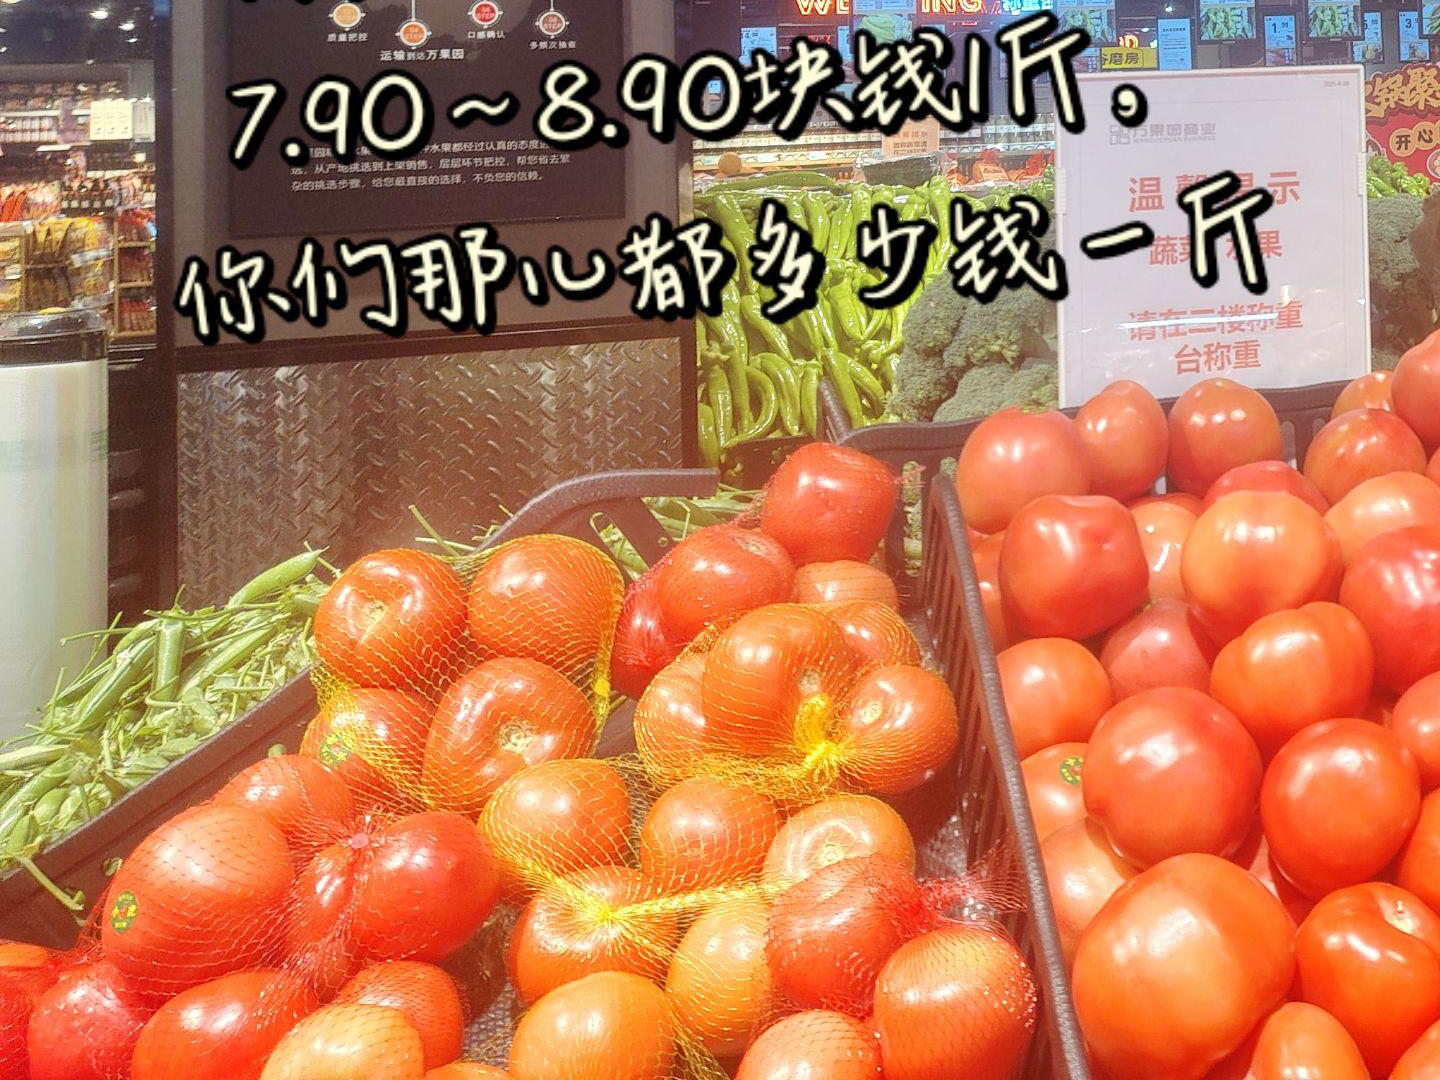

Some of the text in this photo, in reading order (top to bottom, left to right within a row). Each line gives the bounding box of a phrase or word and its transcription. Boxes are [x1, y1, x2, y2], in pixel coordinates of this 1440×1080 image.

[1129, 171, 1300, 213] 温示
[1174, 339, 1261, 375] 台称重
